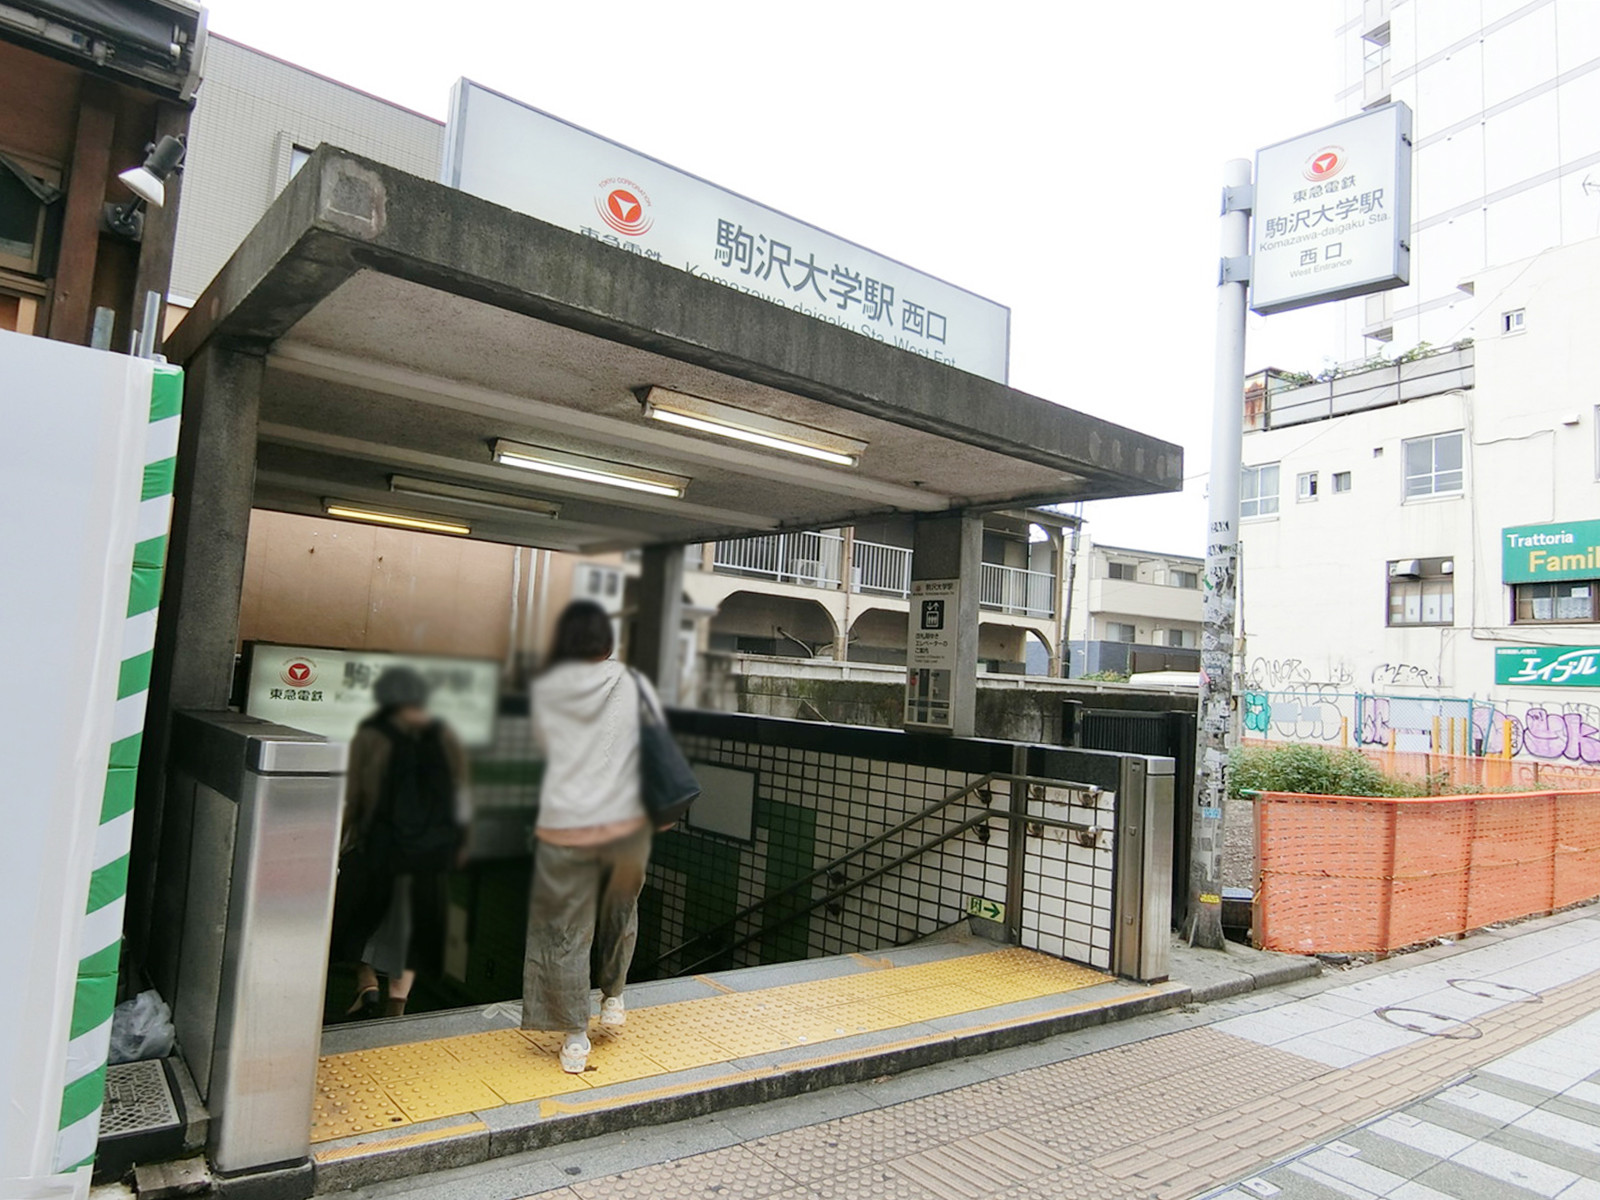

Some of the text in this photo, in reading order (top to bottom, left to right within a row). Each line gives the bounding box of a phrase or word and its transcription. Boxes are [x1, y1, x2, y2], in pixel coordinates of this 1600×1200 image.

[1293, 175, 1356, 204] 東急電鉄
[1265, 188, 1384, 239] 駒沢大学駅
[1259, 213, 1391, 252] Komazawa-daigaku Sta.
[1290, 258, 1352, 278] West Entrance
[1300, 242, 1342, 267] 西口
[714, 218, 948, 345] 駒沢大学駅 西口
[1506, 531, 1573, 548] Trattoria
[1508, 649, 1600, 682] エイブル
[269, 688, 324, 702] 東急電鉄
